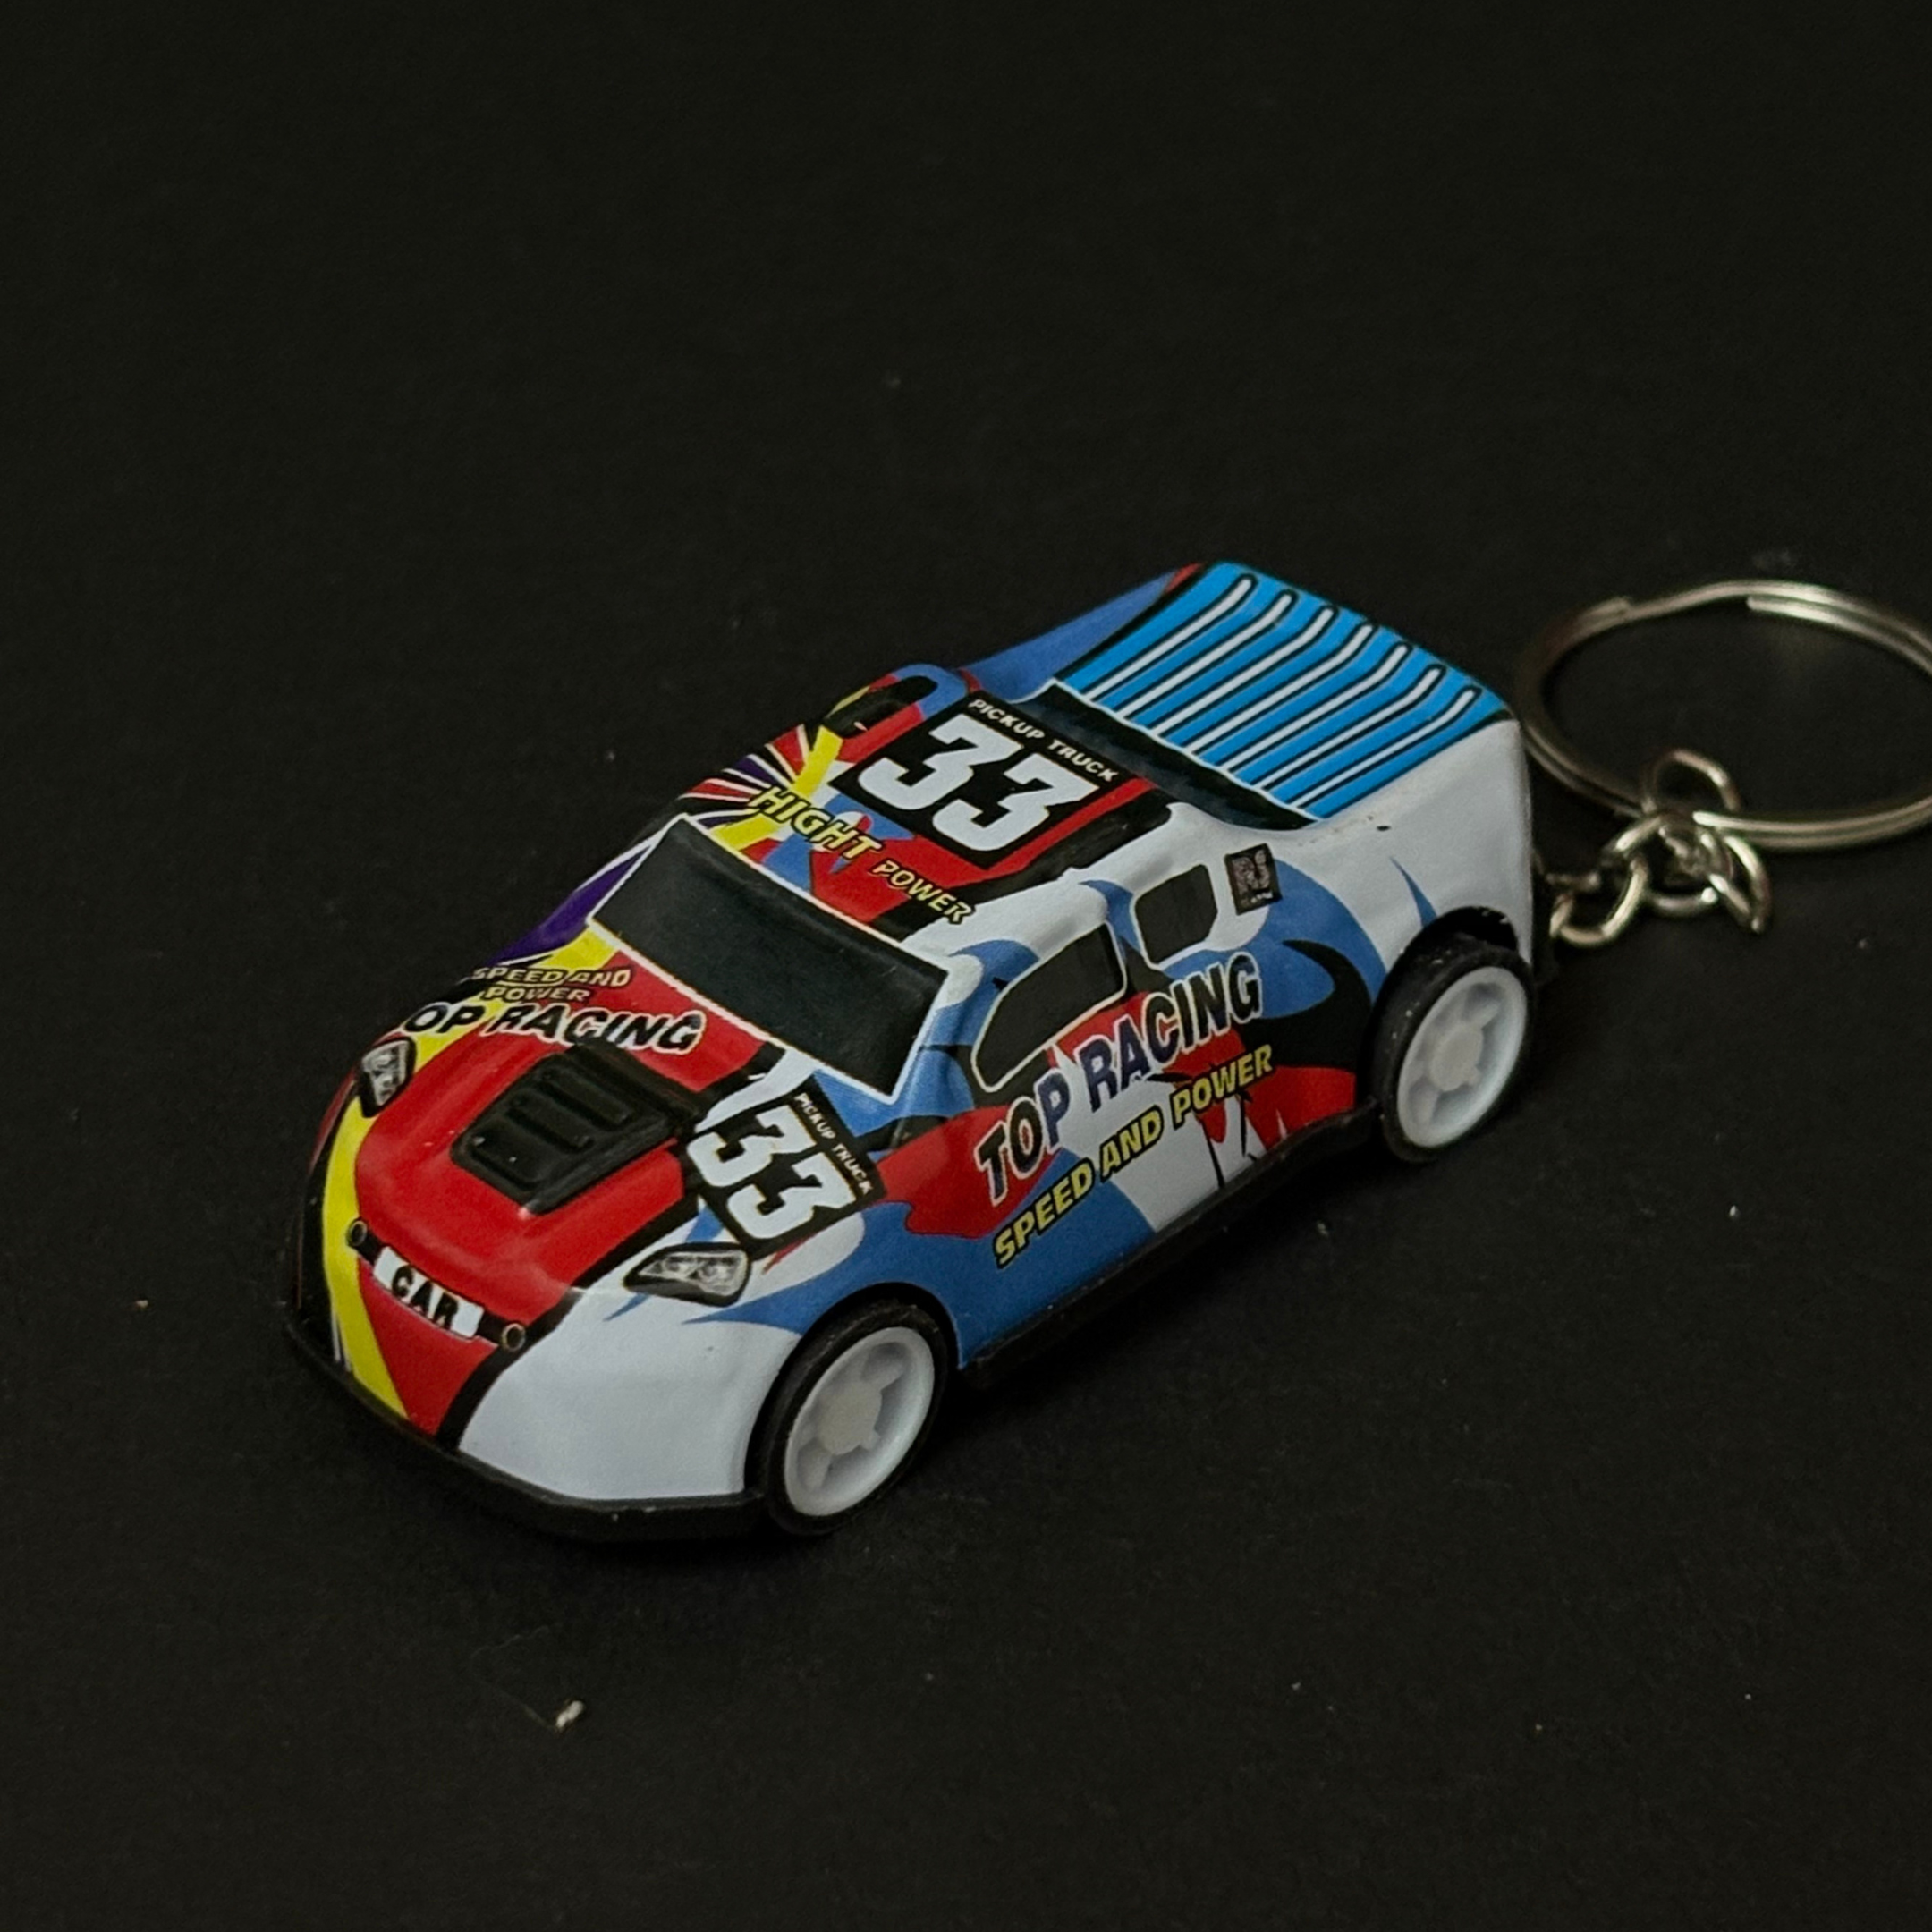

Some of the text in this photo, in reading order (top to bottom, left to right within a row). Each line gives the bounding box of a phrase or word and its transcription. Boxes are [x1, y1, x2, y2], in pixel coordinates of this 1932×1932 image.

[859, 713, 1099, 851] 33
[968, 699, 1119, 783] PICKUP TRUCK
[749, 786, 972, 923] HIGHT POWER
[402, 1002, 705, 1053] OP RACING
[472, 967, 631, 987] SPEED AND
[483, 987, 591, 1002] POWER
[975, 952, 1262, 1206] TOP RACING
[686, 1104, 857, 1240] 33
[794, 1092, 874, 1196] PICKUP TRUCK
[994, 1044, 1274, 1268] SPEED AND POWER
[391, 1264, 460, 1329] CAR
